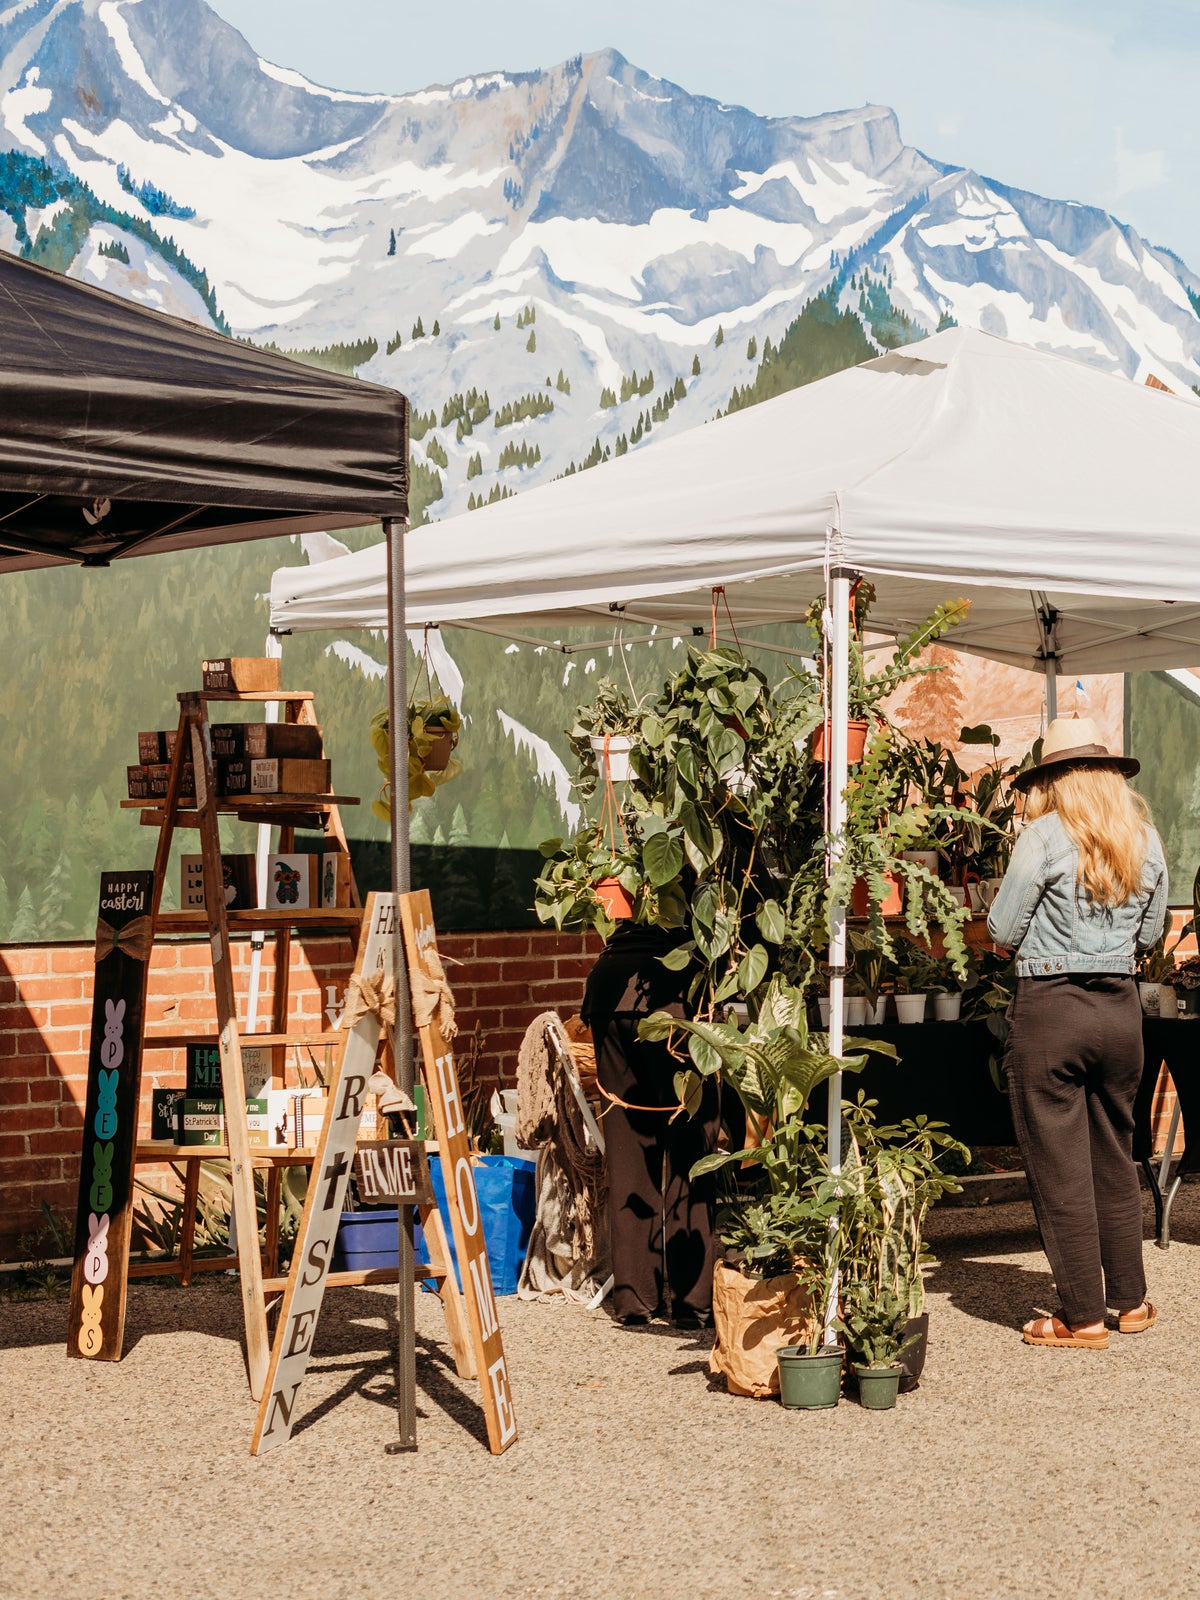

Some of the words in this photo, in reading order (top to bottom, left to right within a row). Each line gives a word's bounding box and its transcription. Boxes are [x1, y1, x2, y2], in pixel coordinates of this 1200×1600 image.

[107, 882, 139, 893] HAPPY
[101, 891, 145, 911] easter!
[197, 1101, 217, 1112] Happy
[249, 1104, 260, 1112] me
[204, 1132, 217, 1143] Day
